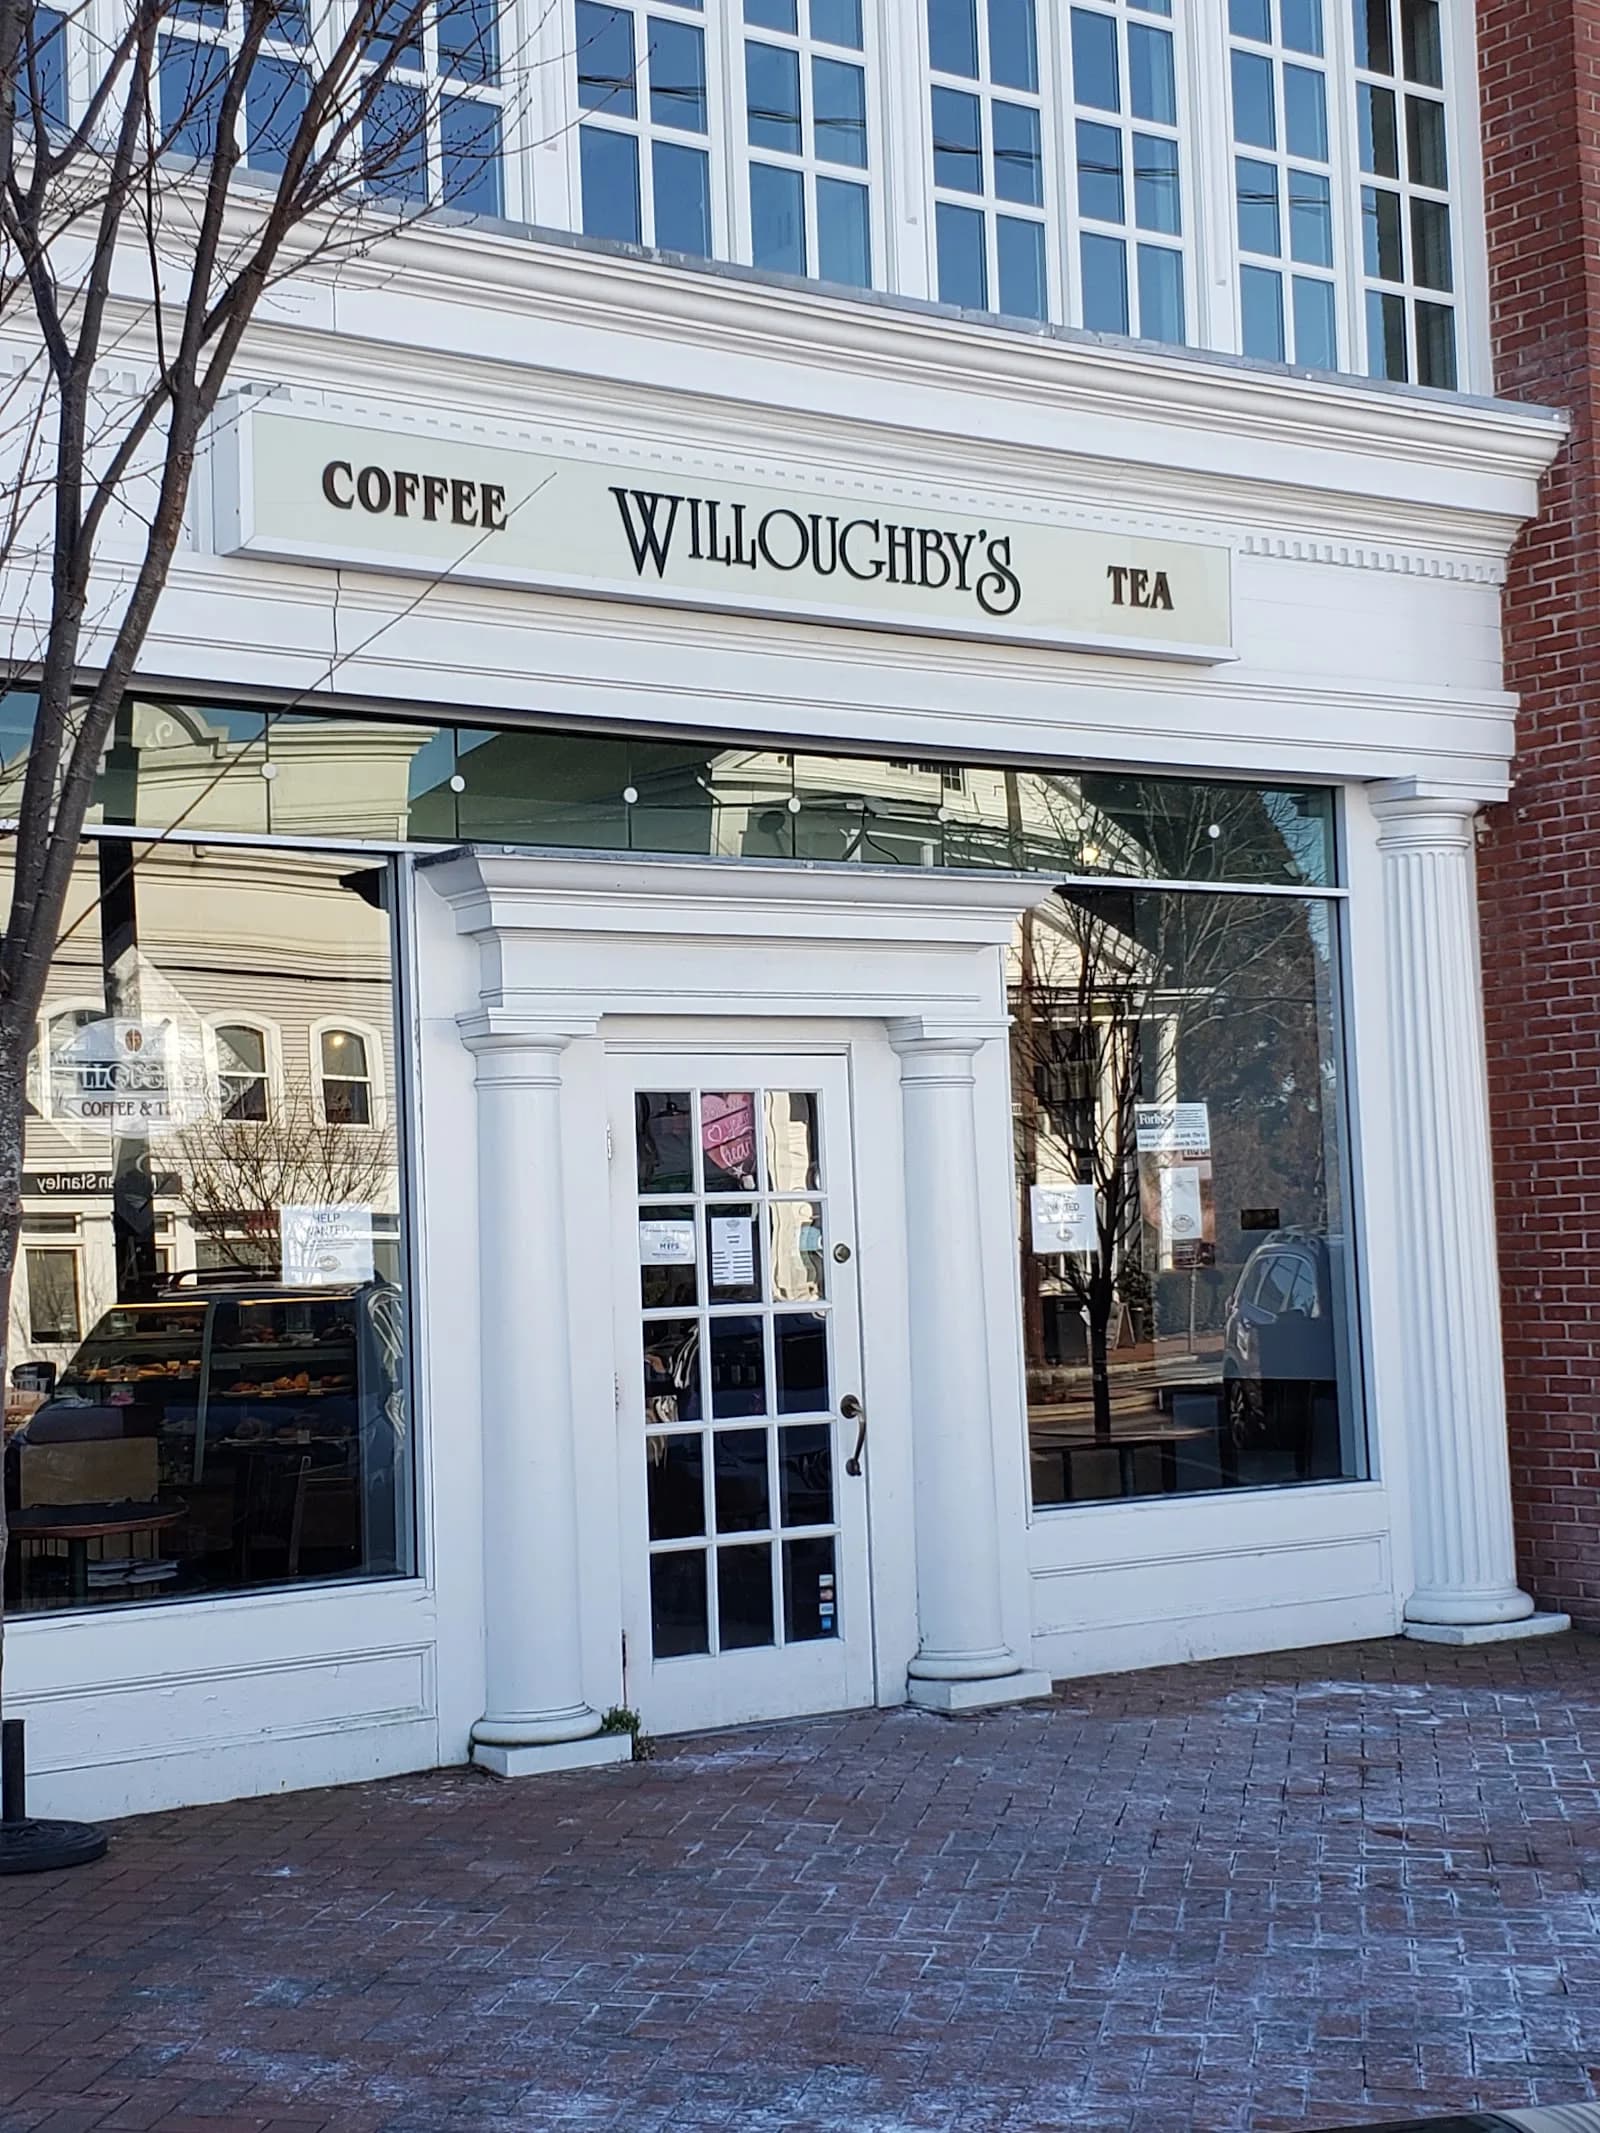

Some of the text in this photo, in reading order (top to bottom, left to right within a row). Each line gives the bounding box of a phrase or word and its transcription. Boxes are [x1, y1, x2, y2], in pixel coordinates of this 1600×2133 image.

[322, 460, 1175, 616] COFFEE WILLOUGHBY'S TEA
[81, 1101, 136, 1116] COFFEE
[139, 1101, 152, 1116] &
